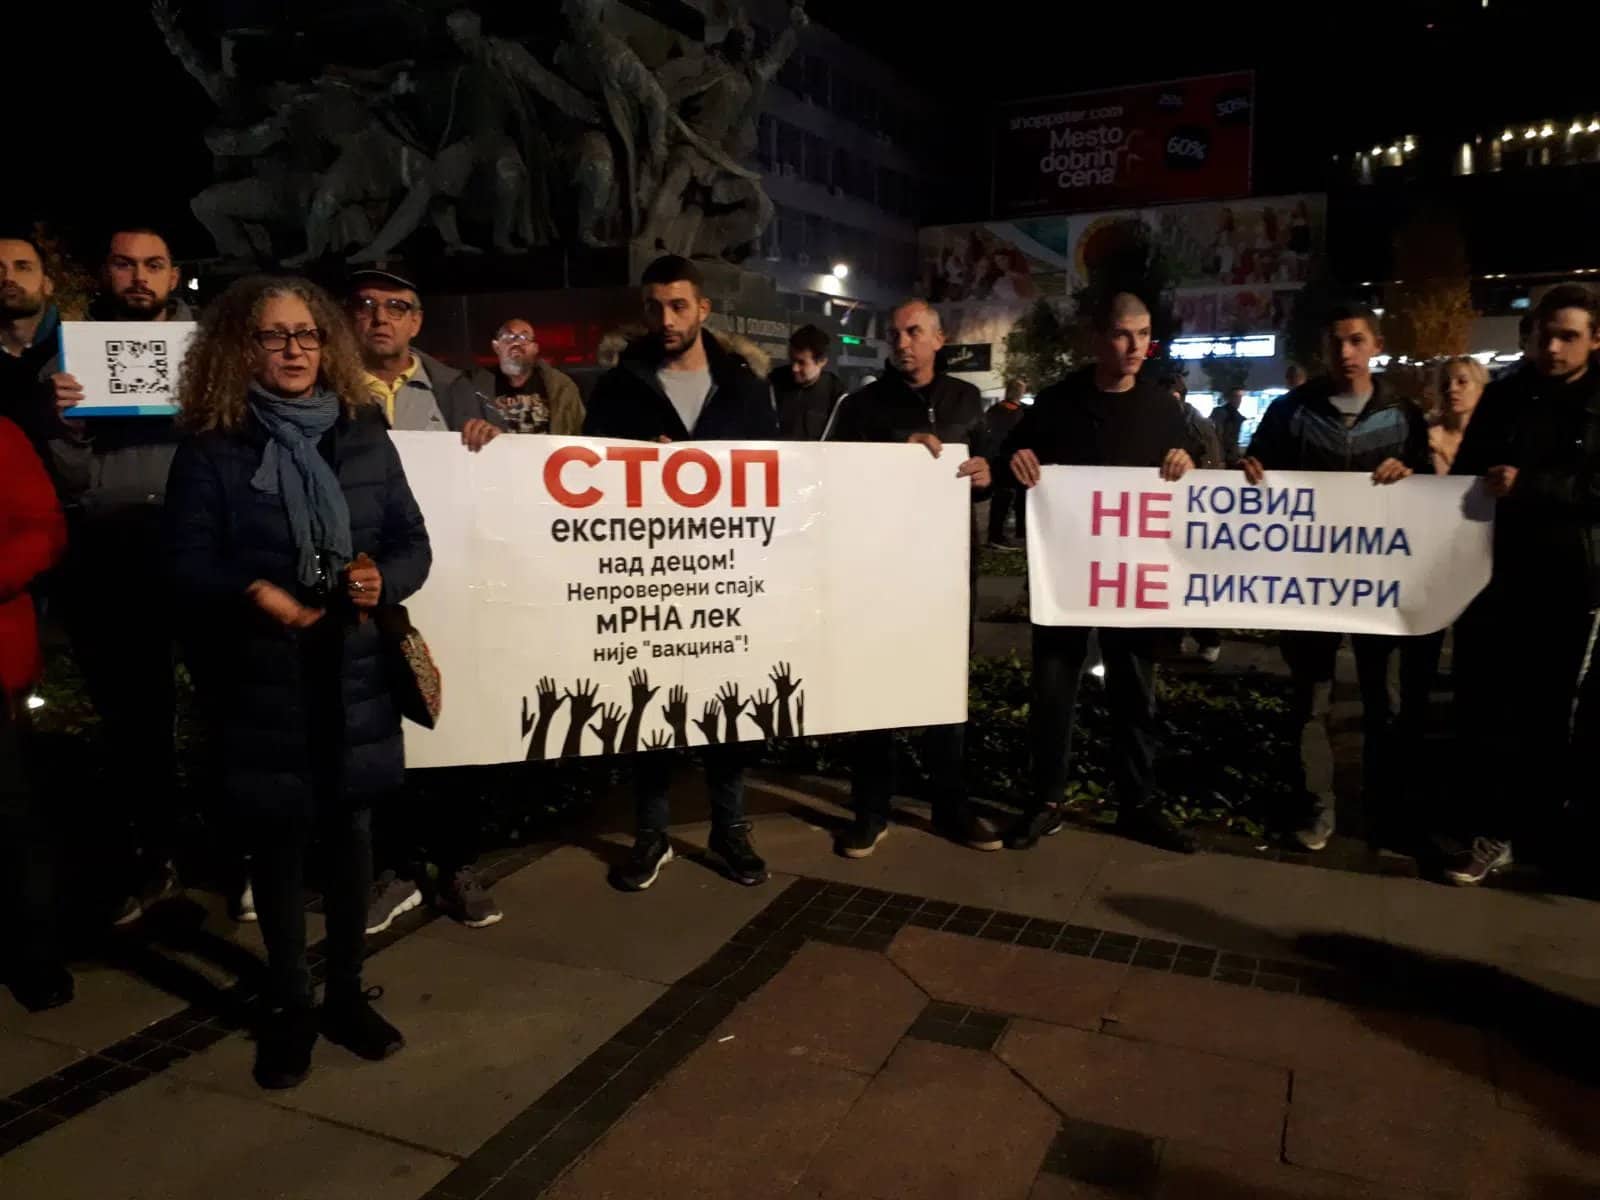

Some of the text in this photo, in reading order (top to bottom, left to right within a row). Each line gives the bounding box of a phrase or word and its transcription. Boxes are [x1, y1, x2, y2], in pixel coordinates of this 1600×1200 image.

[1050, 125, 1123, 149] Mesto
[1167, 136, 1207, 160] 60%
[1040, 146, 1117, 173] dobrih
[1057, 167, 1115, 188] cena
[543, 446, 779, 508] СТОП
[1091, 490, 1173, 539] НЕ
[1187, 485, 1316, 521] КОВИД
[551, 515, 776, 548] експерименту
[1185, 521, 1411, 556] ПАСОШИМА
[598, 549, 735, 576] над децом!
[567, 575, 765, 604] Непроверени спајк
[1088, 561, 1400, 610] НЕ ДИКТАТУРИ
[597, 605, 741, 634] мРНА лек
[593, 635, 749, 663] није "вакцина"!
